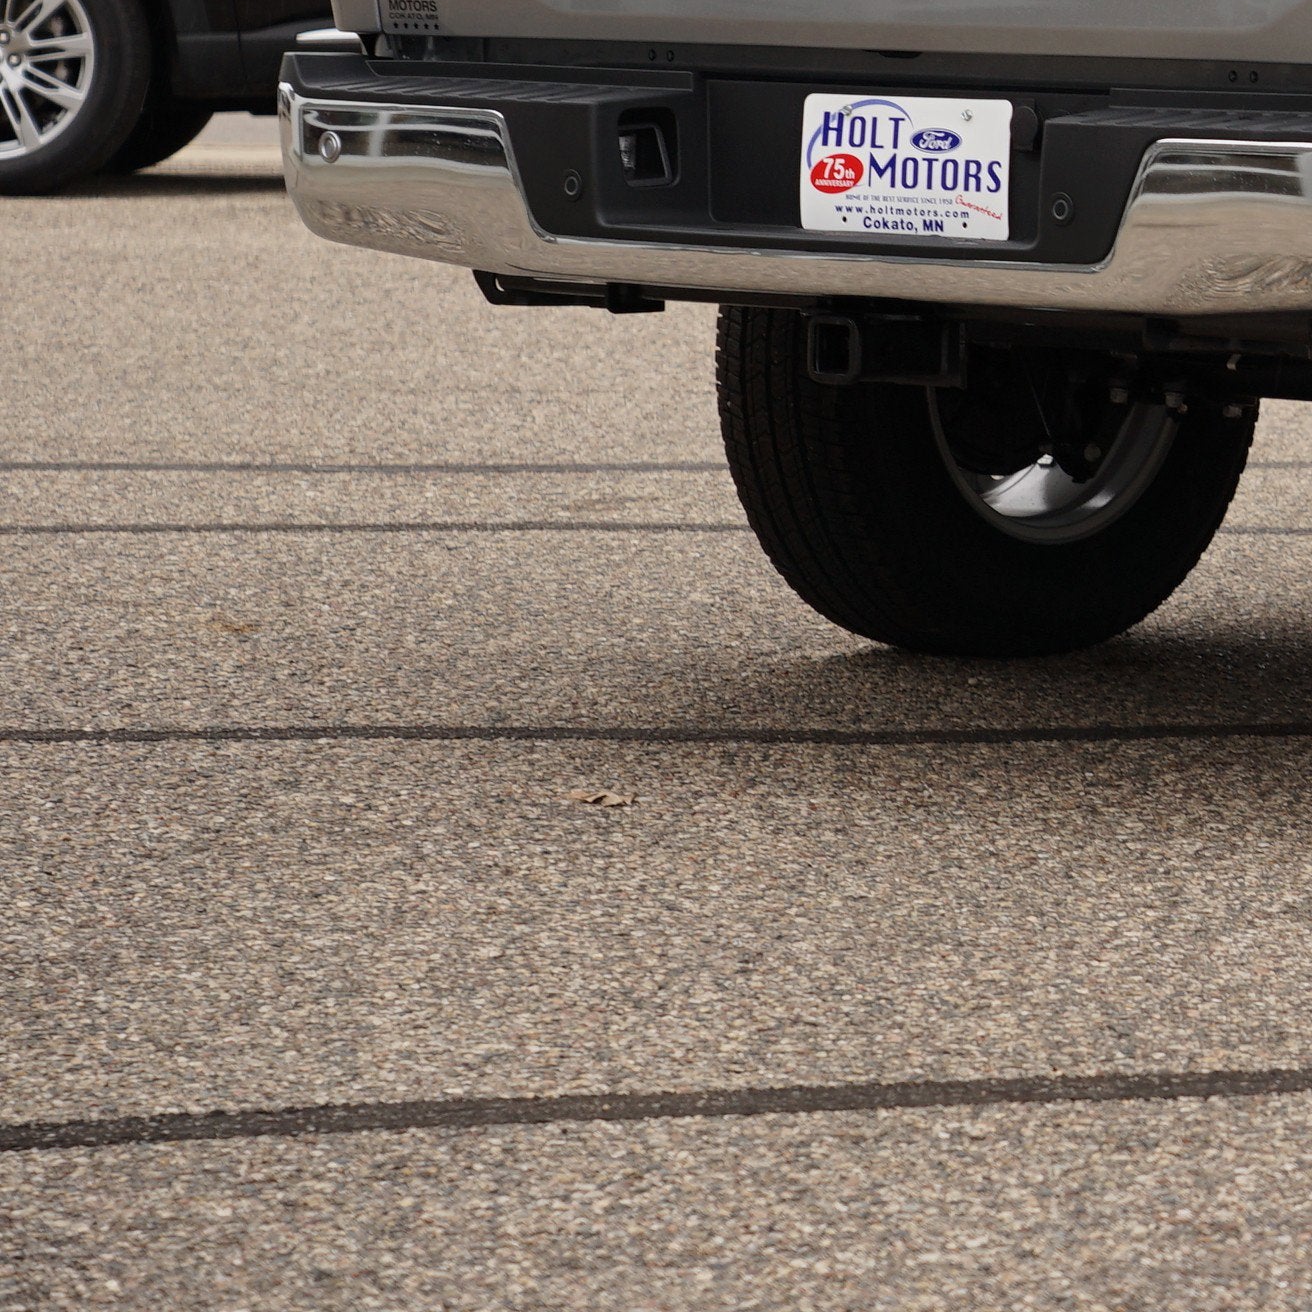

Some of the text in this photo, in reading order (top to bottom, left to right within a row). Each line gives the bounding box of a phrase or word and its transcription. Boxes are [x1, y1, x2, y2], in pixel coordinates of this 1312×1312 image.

[388, 0, 438, 12] MOTORS
[822, 111, 905, 150] HOLT
[918, 130, 952, 151] Ford
[822, 158, 856, 180] 75th
[869, 151, 1003, 194] MOTORS
[814, 178, 855, 188] ANNIVERSARY
[835, 203, 970, 219] www.holtmotors.com
[863, 216, 944, 233] Cokato, MN
